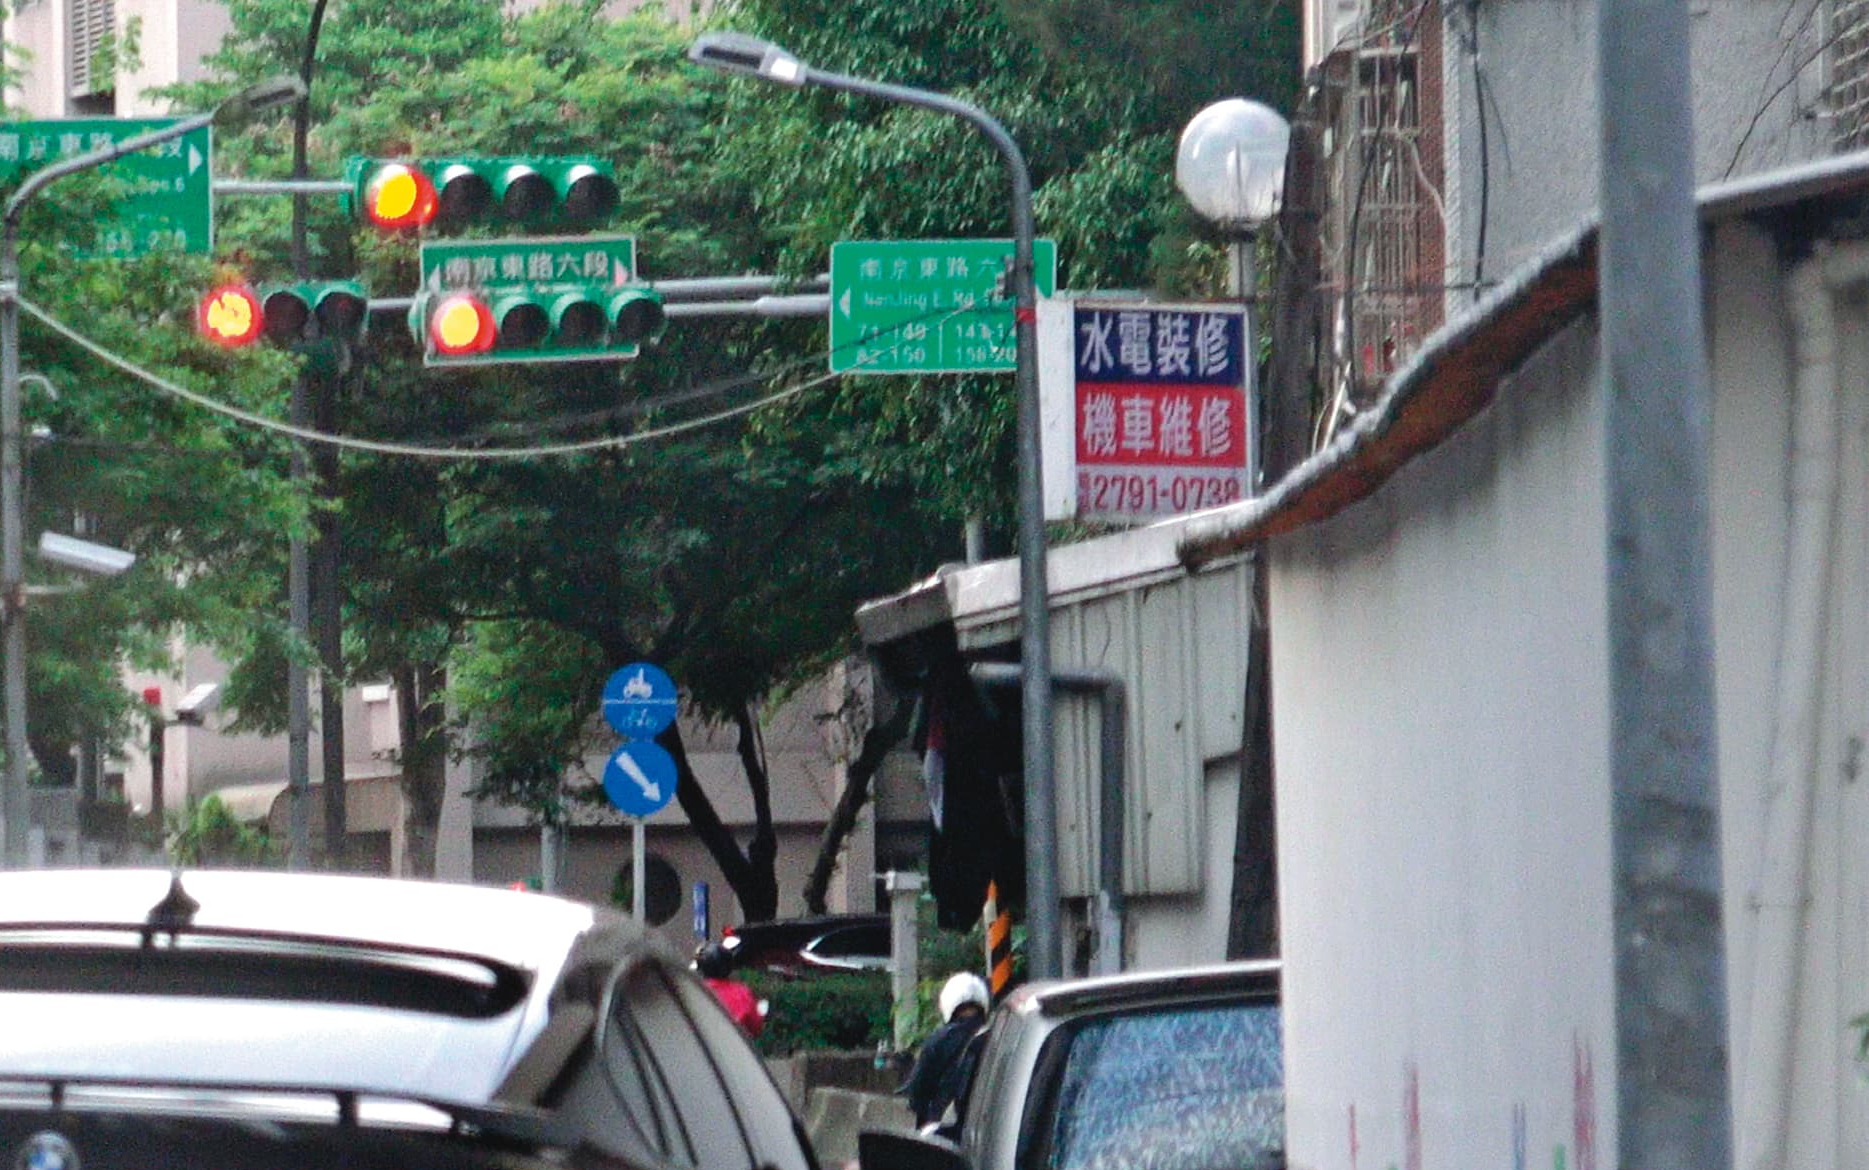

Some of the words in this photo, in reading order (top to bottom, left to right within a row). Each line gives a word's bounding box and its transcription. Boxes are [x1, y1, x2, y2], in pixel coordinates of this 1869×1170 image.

[445, 250, 610, 284] 南京東路六段
[1080, 311, 1230, 377] 水電裝修
[1082, 393, 1233, 457] 機車維修
